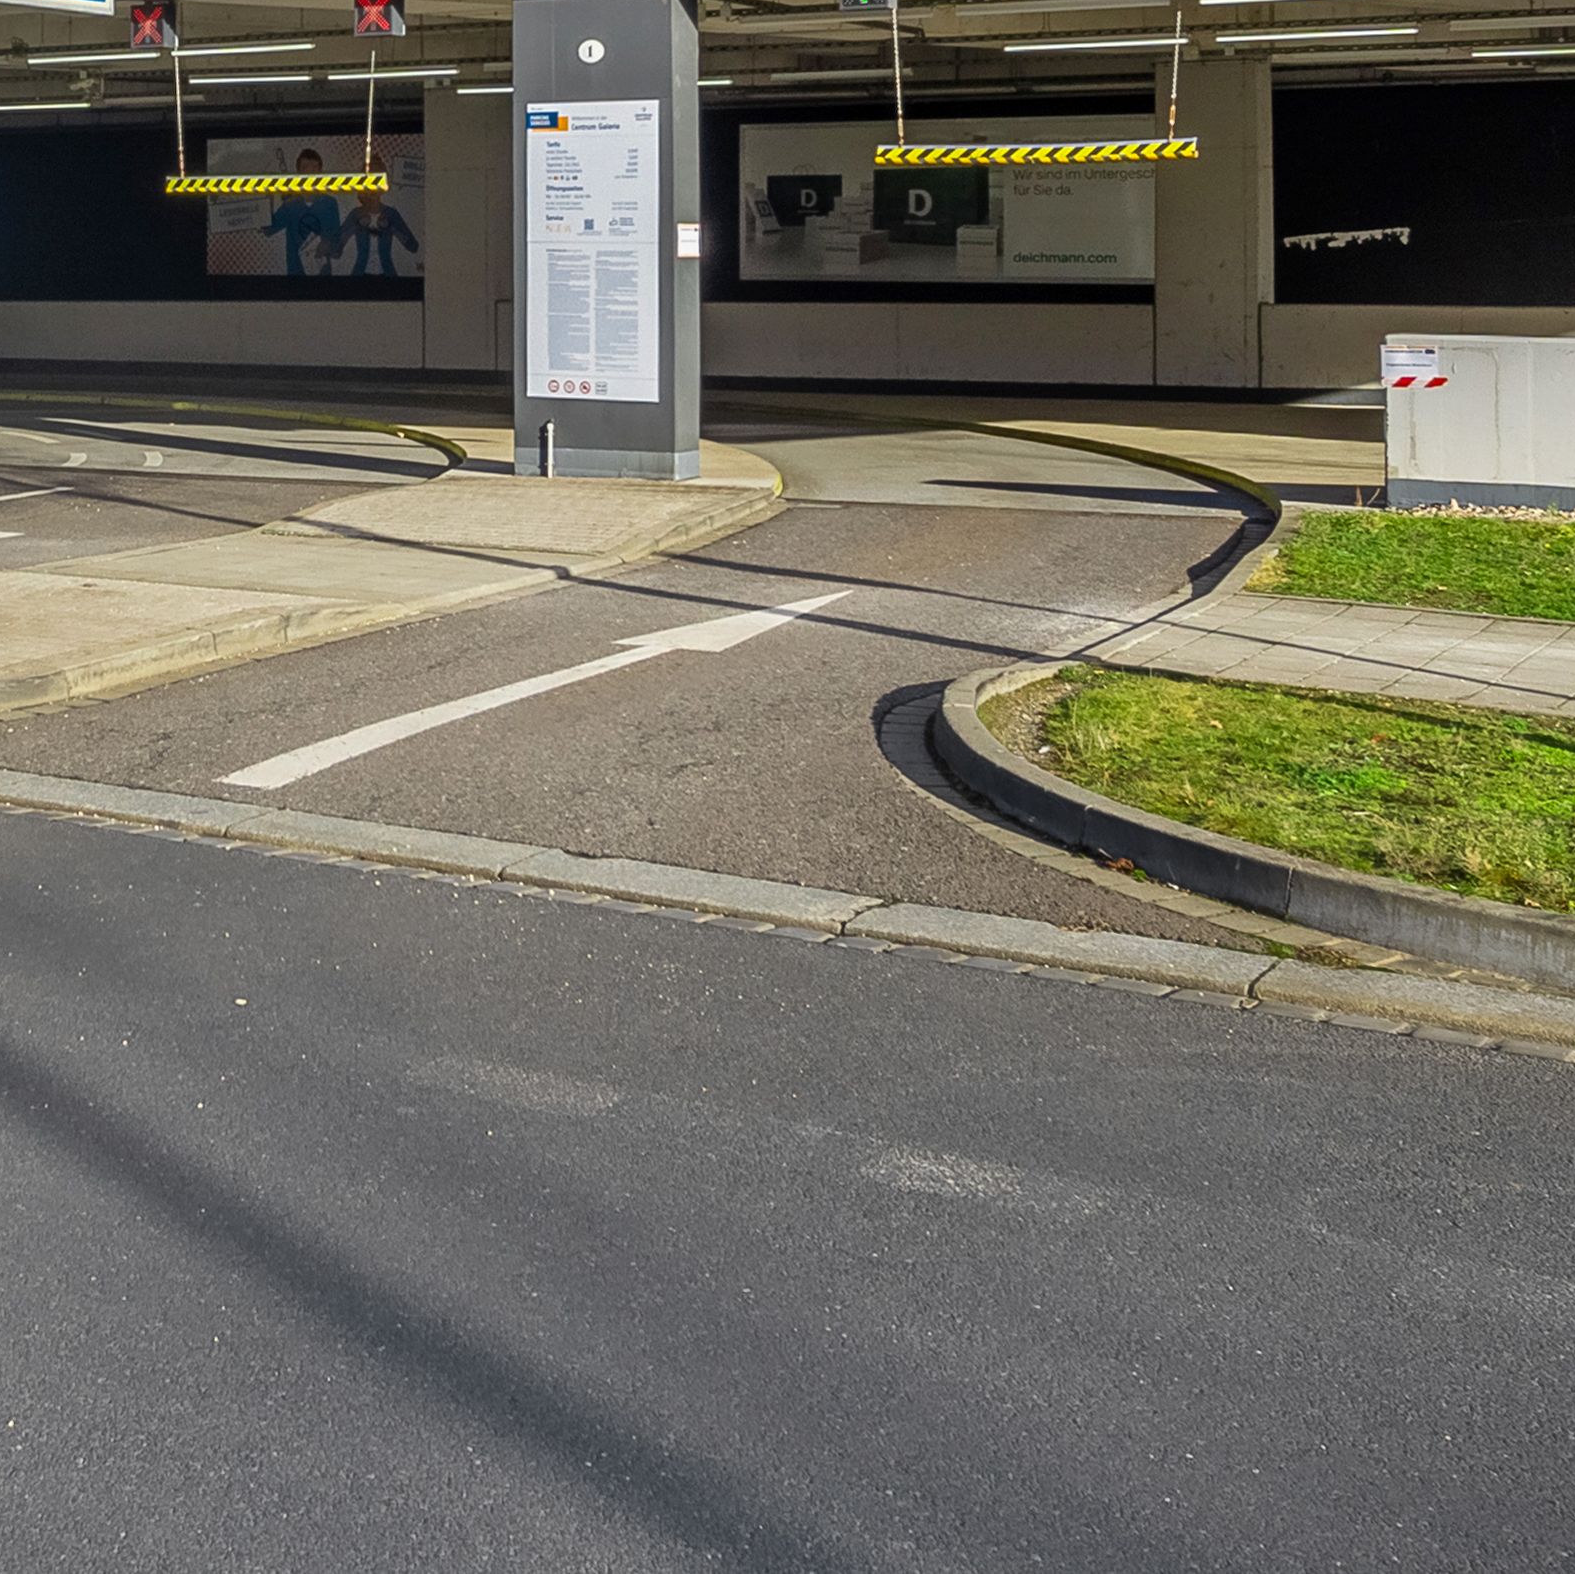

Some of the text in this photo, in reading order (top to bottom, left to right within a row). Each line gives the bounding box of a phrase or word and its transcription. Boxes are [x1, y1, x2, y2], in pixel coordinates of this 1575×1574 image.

[1013, 169, 1033, 180] Wir
[1036, 169, 1062, 180] sind
[1066, 169, 1081, 180] im
[1013, 184, 1074, 196] für Sie da.
[800, 189, 817, 208] D
[908, 189, 933, 216] D
[1013, 252, 1117, 264] deichmann.com
